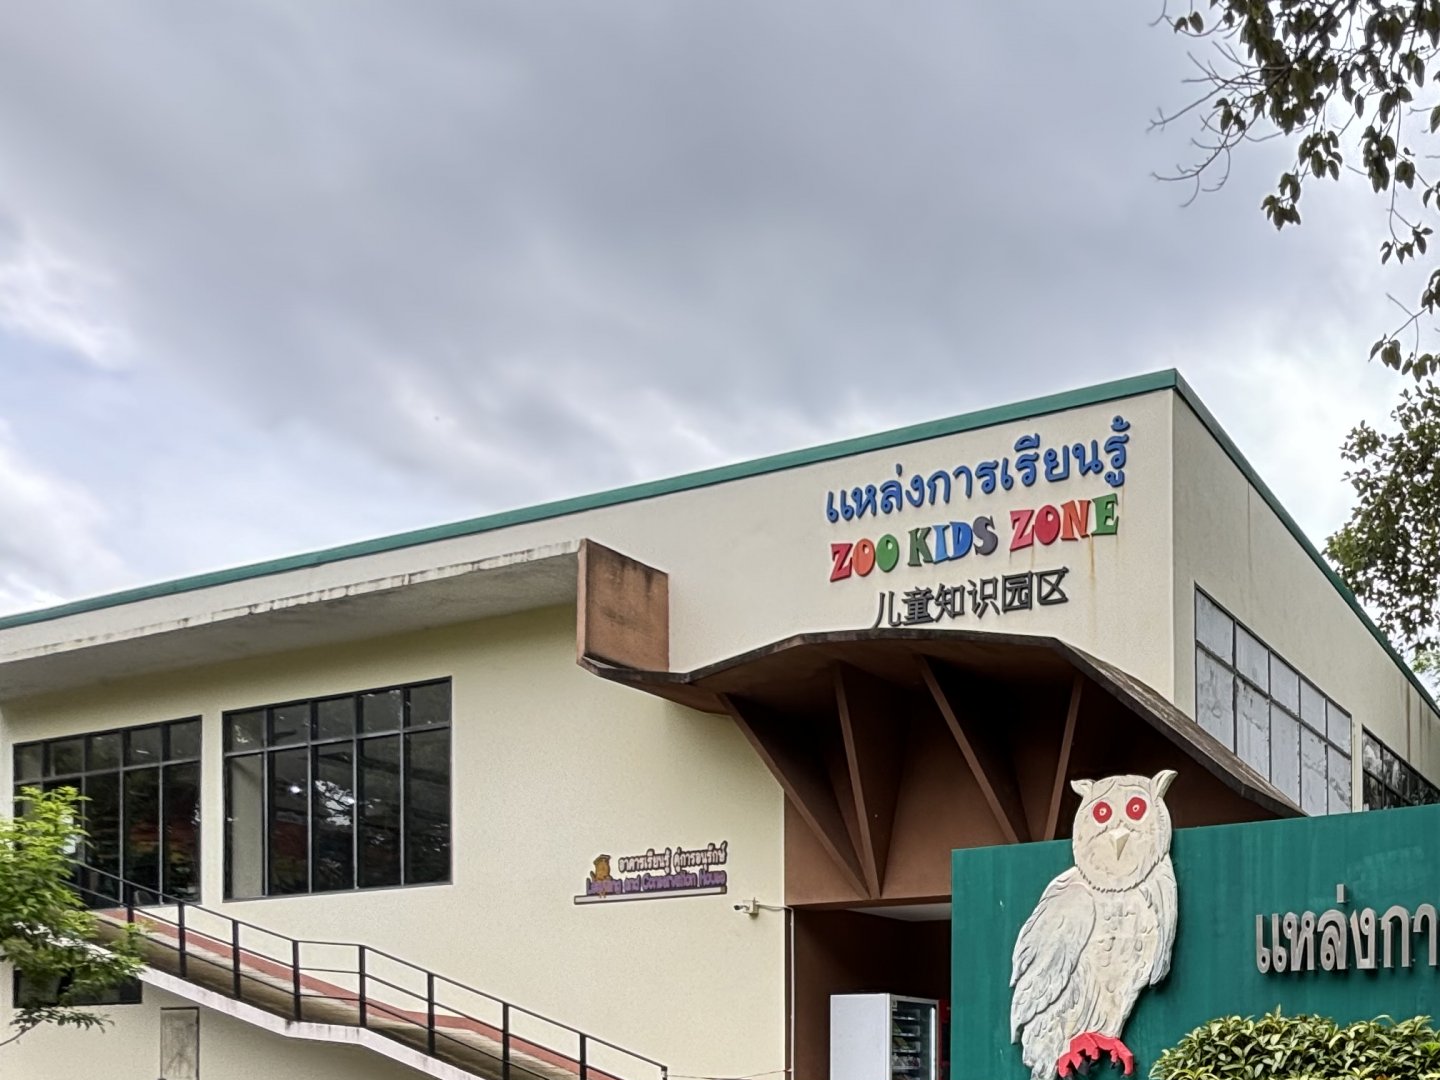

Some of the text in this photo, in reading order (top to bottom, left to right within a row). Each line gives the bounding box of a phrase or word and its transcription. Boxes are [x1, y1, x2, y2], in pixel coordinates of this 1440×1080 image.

[826, 415, 1130, 523] แหล่งการเรียนรู้
[830, 493, 1119, 582] ZOO KIDS ZONE
[873, 567, 1069, 629] 儿童知识园区
